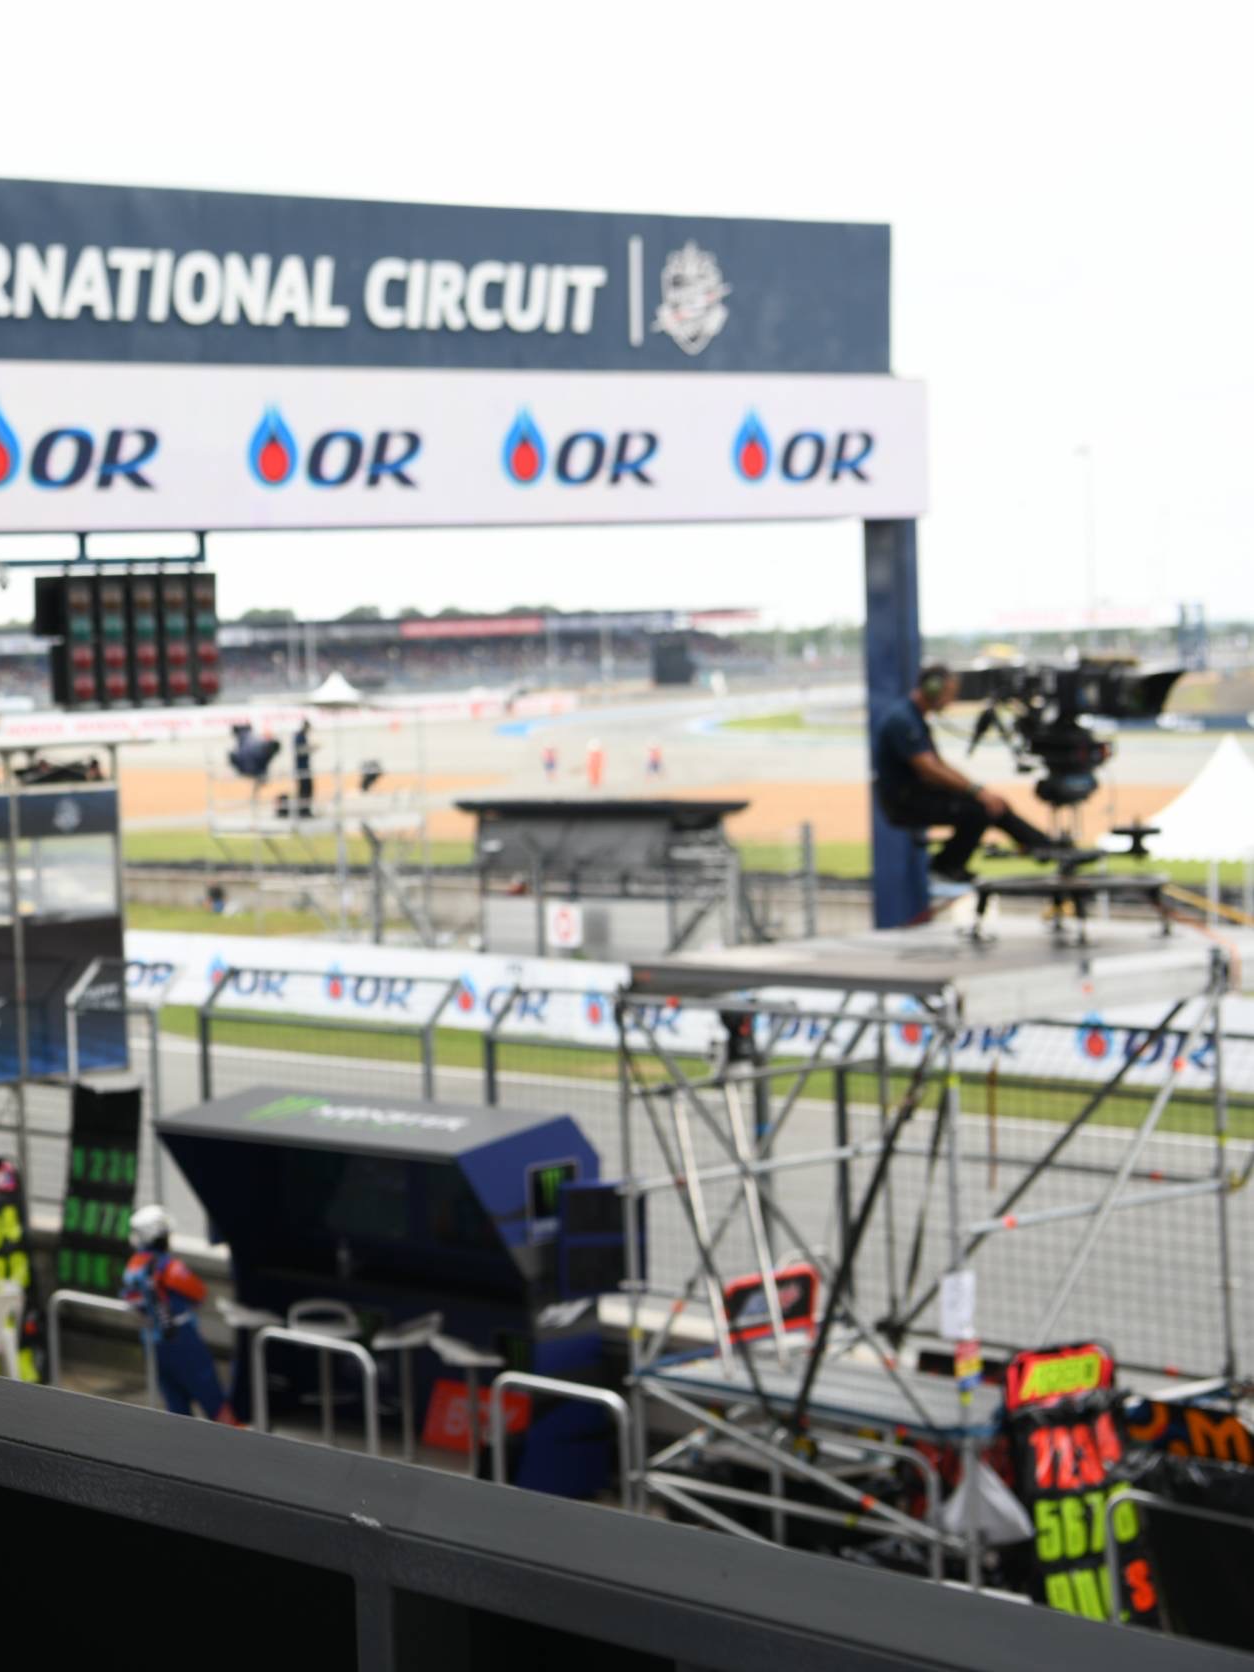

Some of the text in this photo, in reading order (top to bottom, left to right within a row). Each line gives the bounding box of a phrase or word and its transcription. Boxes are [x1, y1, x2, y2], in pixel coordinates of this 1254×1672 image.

[364, 257, 607, 334] CIRCUIT
[29, 427, 159, 491] OR
[306, 430, 422, 488] OR
[554, 431, 659, 487] OR
[779, 431, 875, 484] OR
[352, 974, 414, 1011] OR
